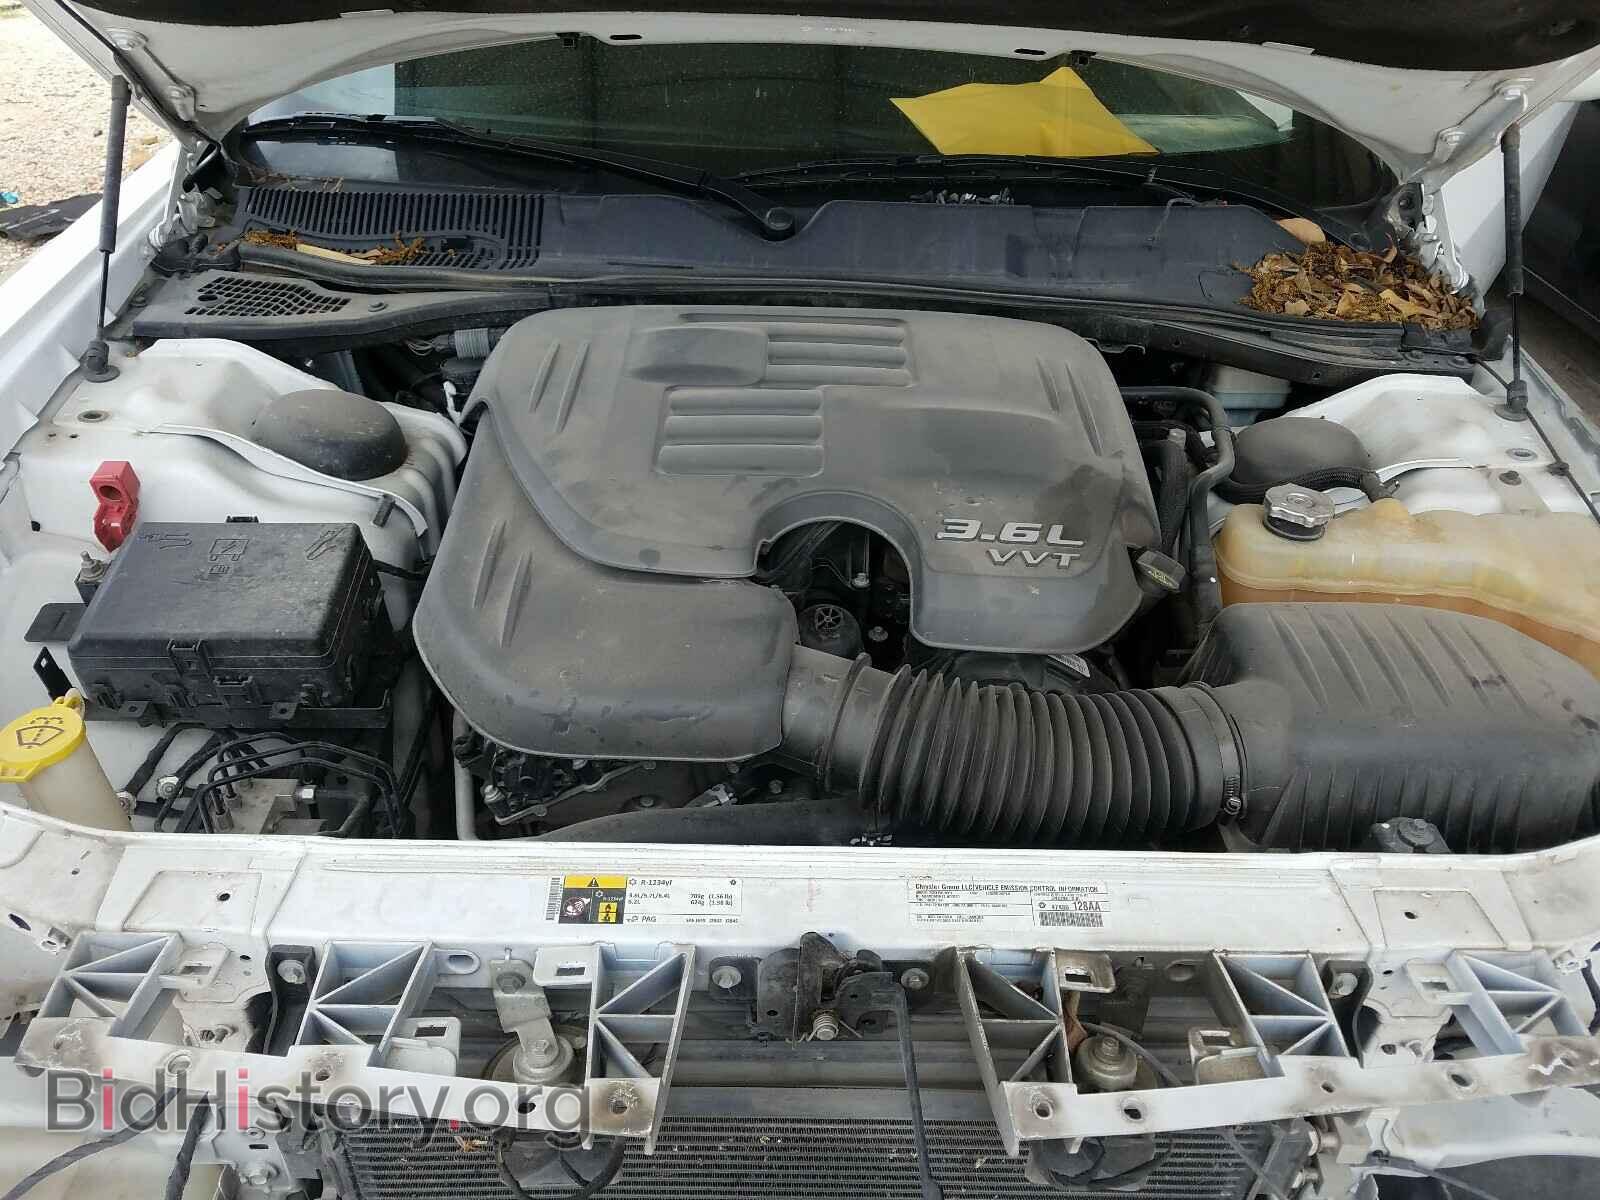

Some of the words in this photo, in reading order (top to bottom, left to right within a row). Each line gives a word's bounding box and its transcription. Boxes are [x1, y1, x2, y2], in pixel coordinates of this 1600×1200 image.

[935, 518, 1085, 546] 3.6L
[987, 548, 1081, 569] VVT
[1072, 901, 1101, 912] 128AA
[641, 915, 657, 923] PAG
